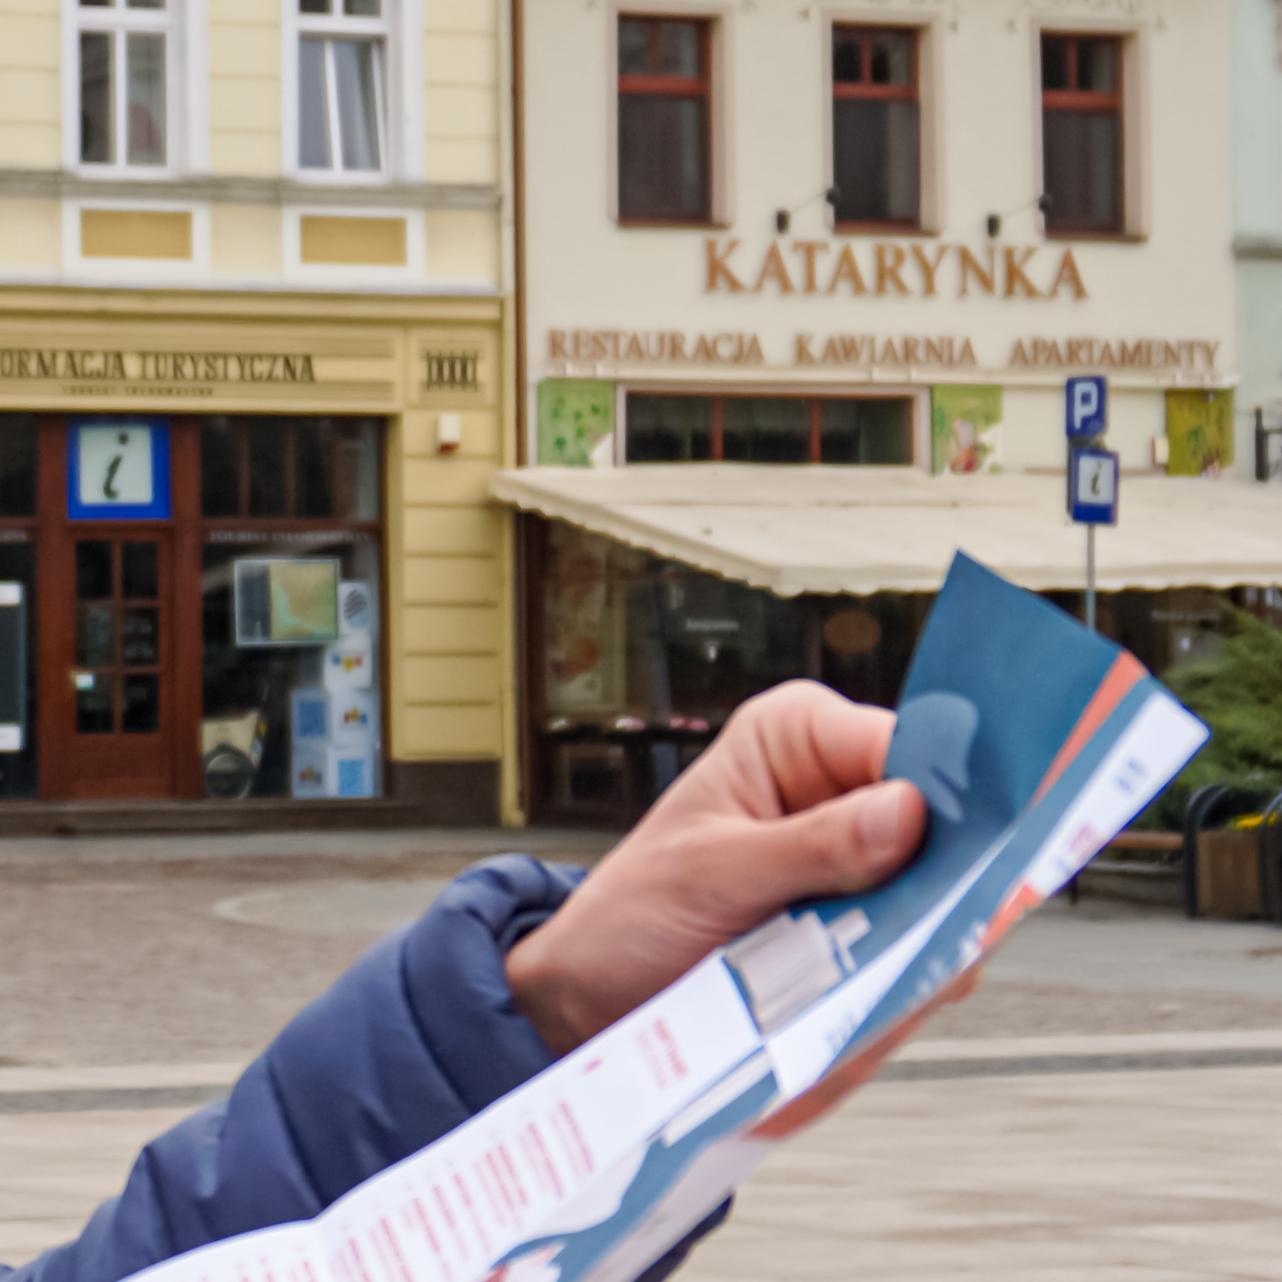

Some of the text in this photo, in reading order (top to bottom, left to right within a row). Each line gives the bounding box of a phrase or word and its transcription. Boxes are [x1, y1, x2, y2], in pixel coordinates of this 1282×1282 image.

[702, 237, 1090, 299] KATARYNKA
[138, 351, 317, 383] TURYSTYCZNA
[547, 328, 1222, 369] RESTAURACJA KAWIARNIA APARTAMENTY
[1073, 381, 1099, 430] P
